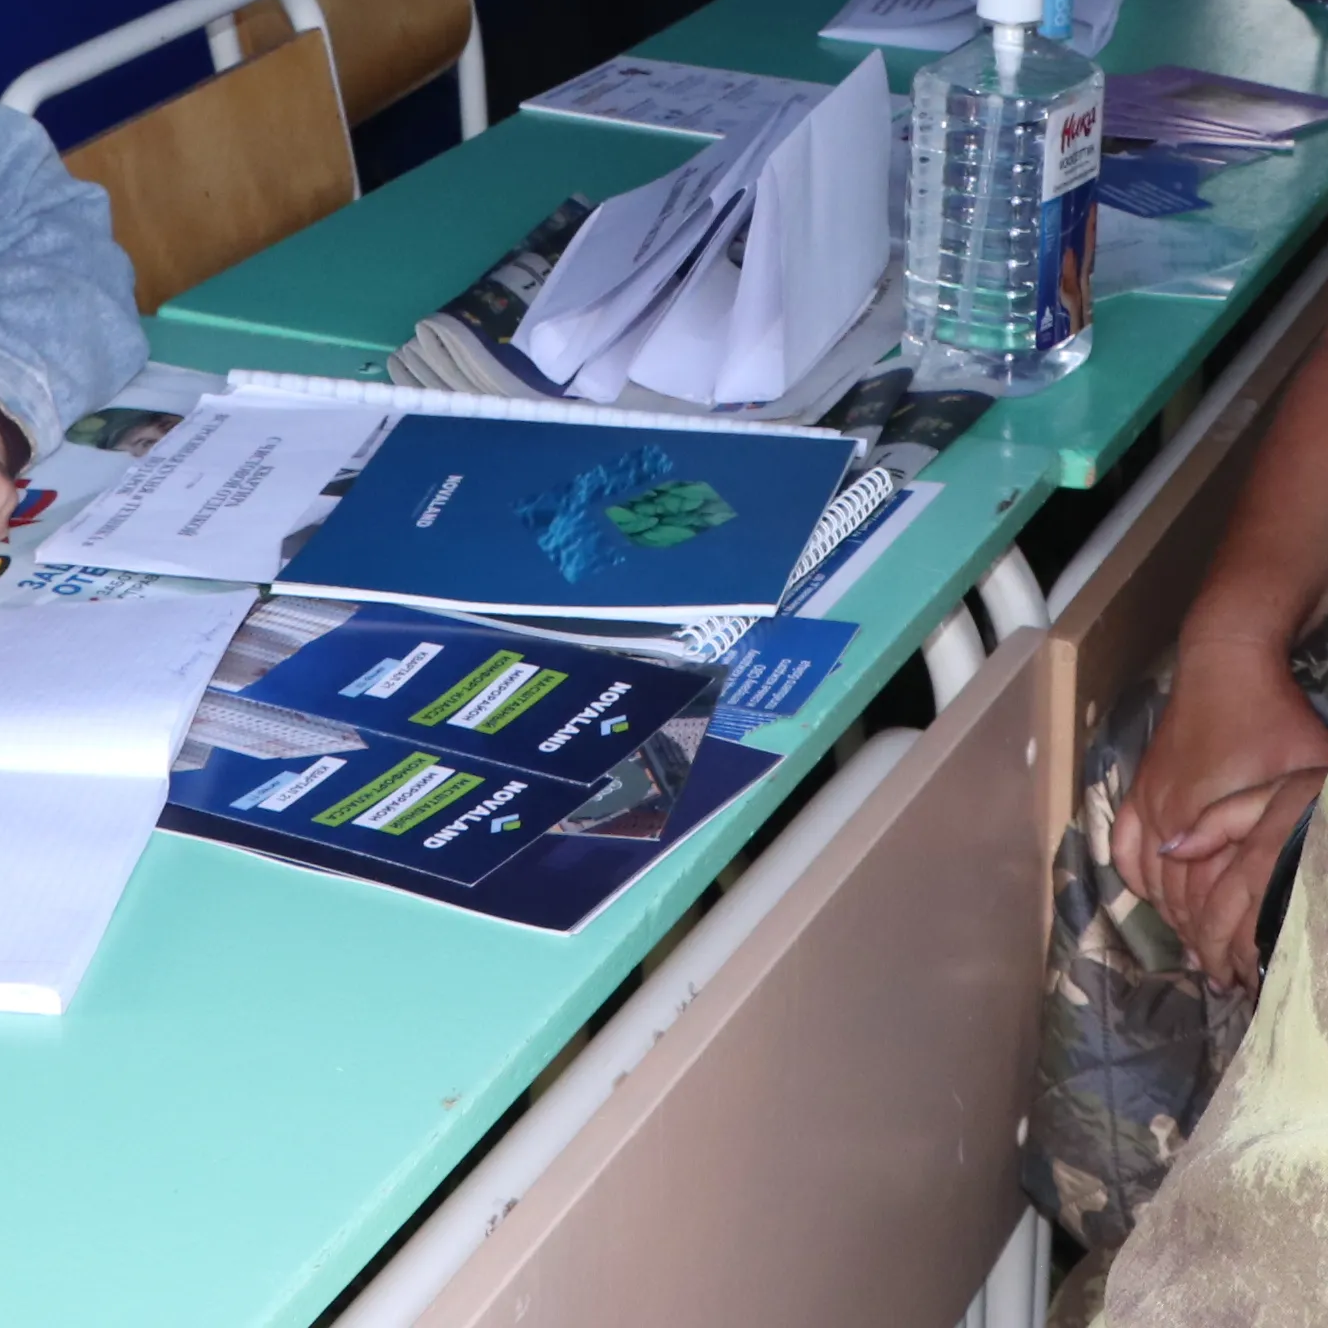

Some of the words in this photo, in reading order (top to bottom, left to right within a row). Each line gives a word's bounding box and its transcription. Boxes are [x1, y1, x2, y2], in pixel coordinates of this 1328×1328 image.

[224, 465, 276, 507] КВАРТИРА
[415, 474, 463, 528] NOVALAND
[421, 655, 510, 720] КОМФОРТ-КЛАССА
[463, 668, 525, 721] МИКРОРАЙОН
[487, 674, 555, 729] МАСШТАБНЫЙ
[538, 681, 632, 753] NOVALAND
[326, 757, 427, 821] КОМФОРТ-КЛАССА
[371, 772, 436, 821] МИКРОРАЙОН
[389, 778, 470, 829] МАСШТАБНЫЙ
[423, 780, 528, 849] NOVALAND
